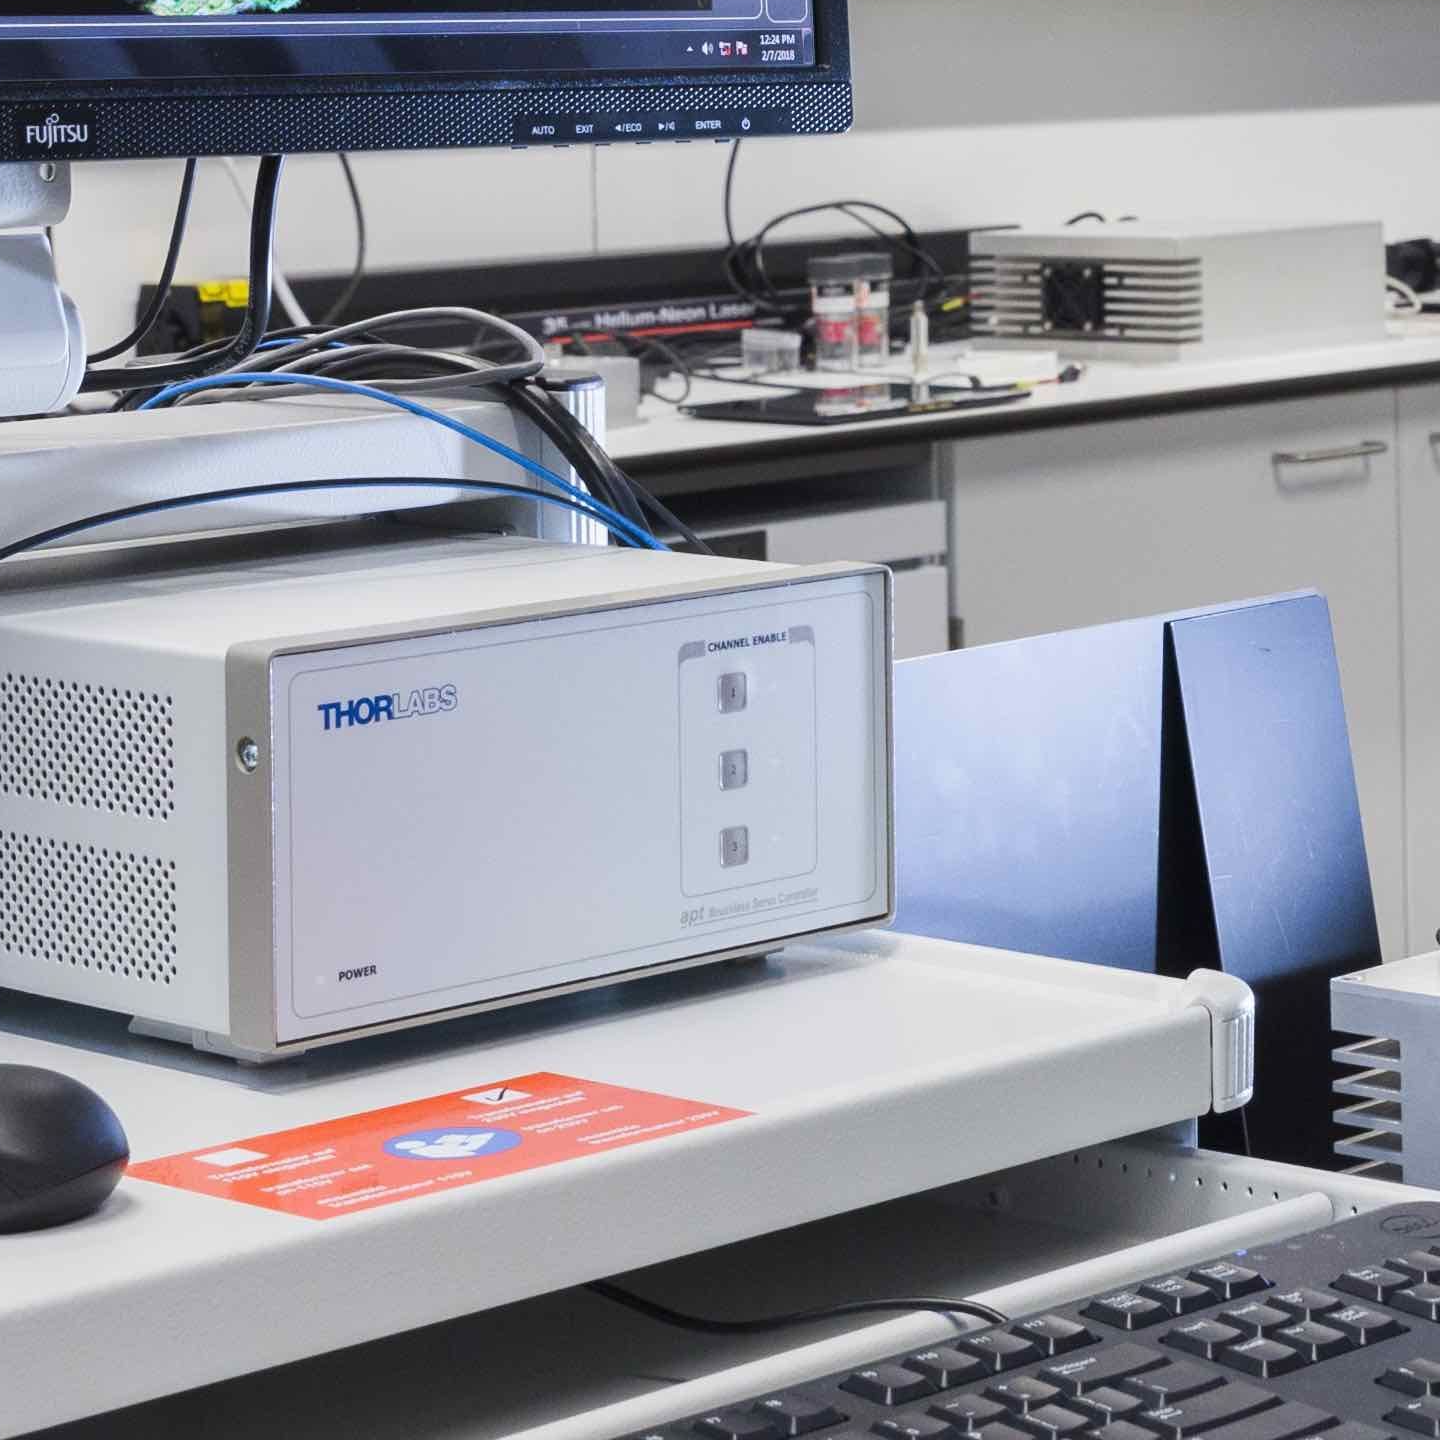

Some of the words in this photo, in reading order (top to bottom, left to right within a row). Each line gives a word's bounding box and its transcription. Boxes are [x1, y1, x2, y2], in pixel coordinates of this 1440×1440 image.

[760, 34, 781, 46] 12:24
[782, 33, 796, 46] PM
[762, 48, 796, 62] 2/7/2018
[532, 124, 556, 136] AUTO
[575, 123, 594, 134] EXIT
[695, 119, 723, 131] ENTER
[25, 120, 90, 149] FUJITSU
[593, 306, 707, 328] Helium-Neon
[707, 636, 751, 654] CHANNEL
[752, 630, 788, 647] ENABLE
[317, 682, 459, 732] THORLABS
[337, 962, 378, 983] POWER
